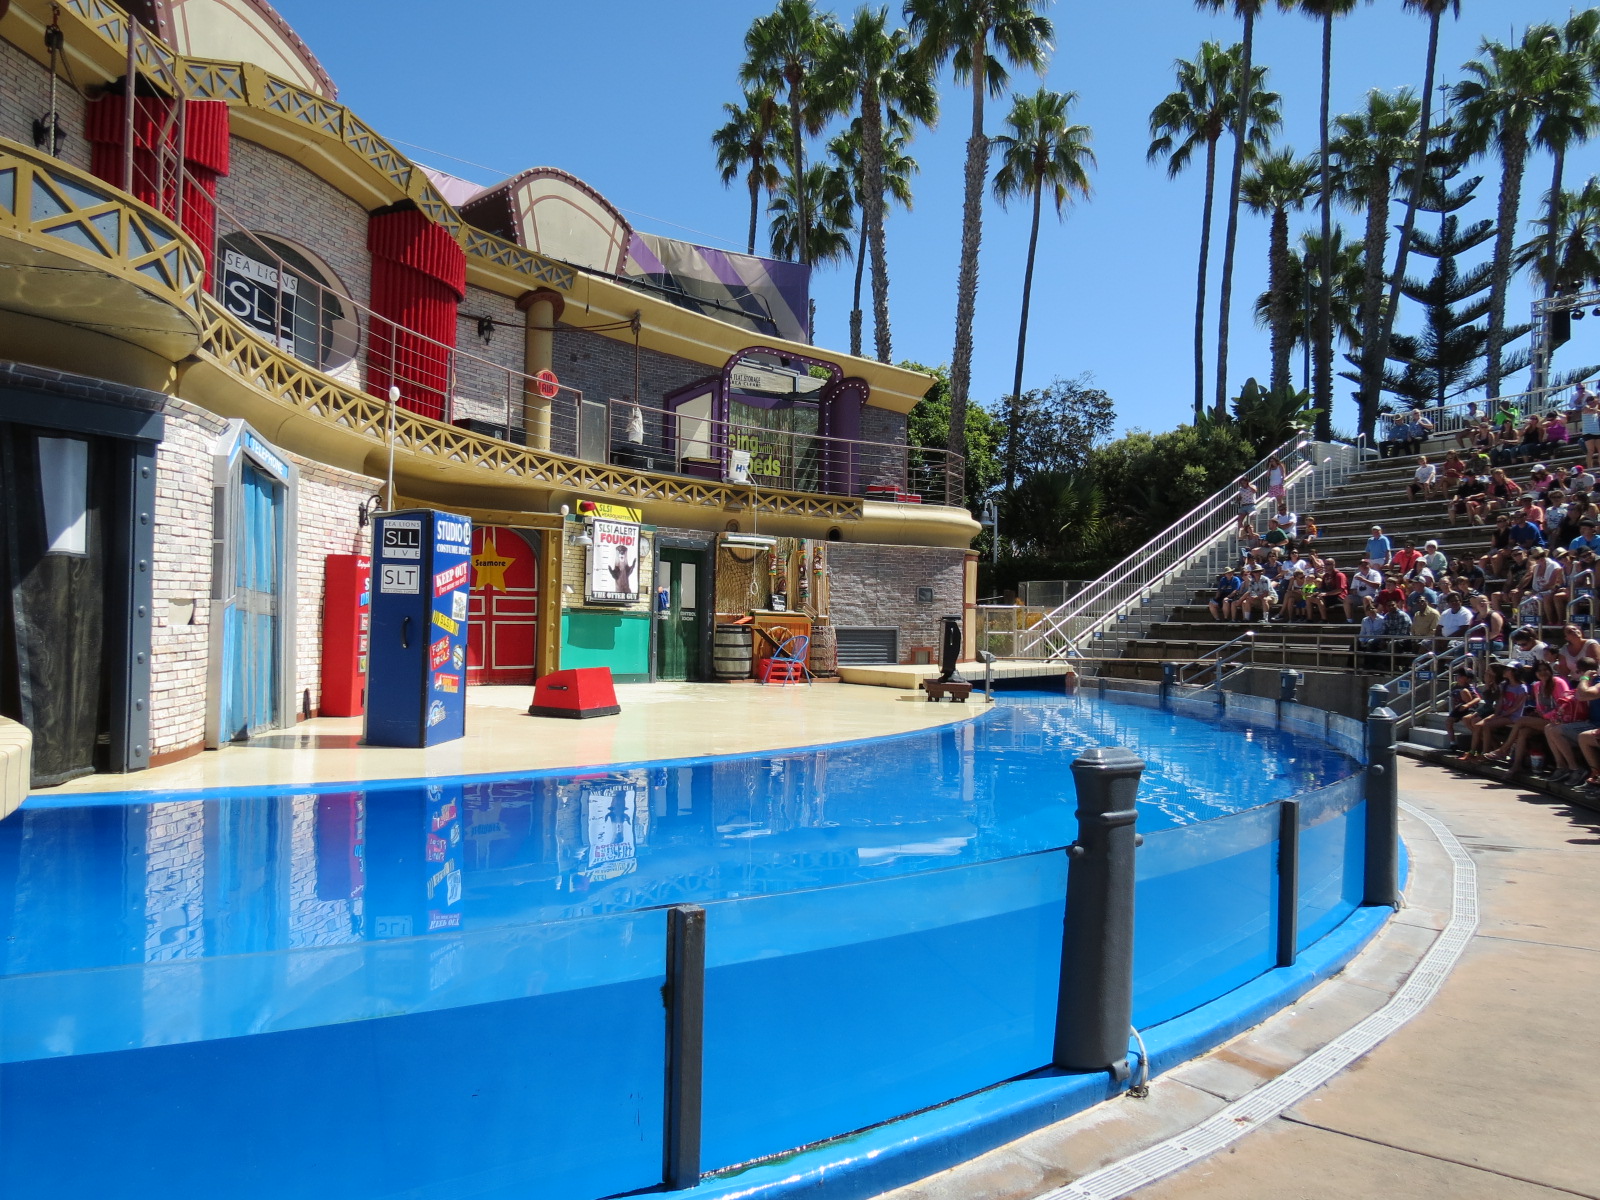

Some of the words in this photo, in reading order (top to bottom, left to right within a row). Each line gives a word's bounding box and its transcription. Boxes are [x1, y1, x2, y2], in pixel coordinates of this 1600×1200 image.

[227, 253, 251, 273] SEA
[257, 265, 297, 290] LIONS
[542, 383, 554, 394] AIR
[250, 437, 283, 475] TELEPHONE
[599, 504, 612, 513] SLSI
[436, 520, 463, 543] STUDIO
[598, 524, 613, 533] SLSI
[614, 526, 637, 536] ALERT
[385, 531, 419, 546] SLL
[600, 533, 635, 547] FOUND!
[383, 549, 419, 557] LIVE
[436, 543, 459, 554] COSTUME
[475, 559, 506, 567] Seamore
[384, 569, 416, 585] SLT
[435, 568, 454, 588] KEEP
[454, 562, 468, 578] OUT
[606, 592, 626, 600] OTTER
